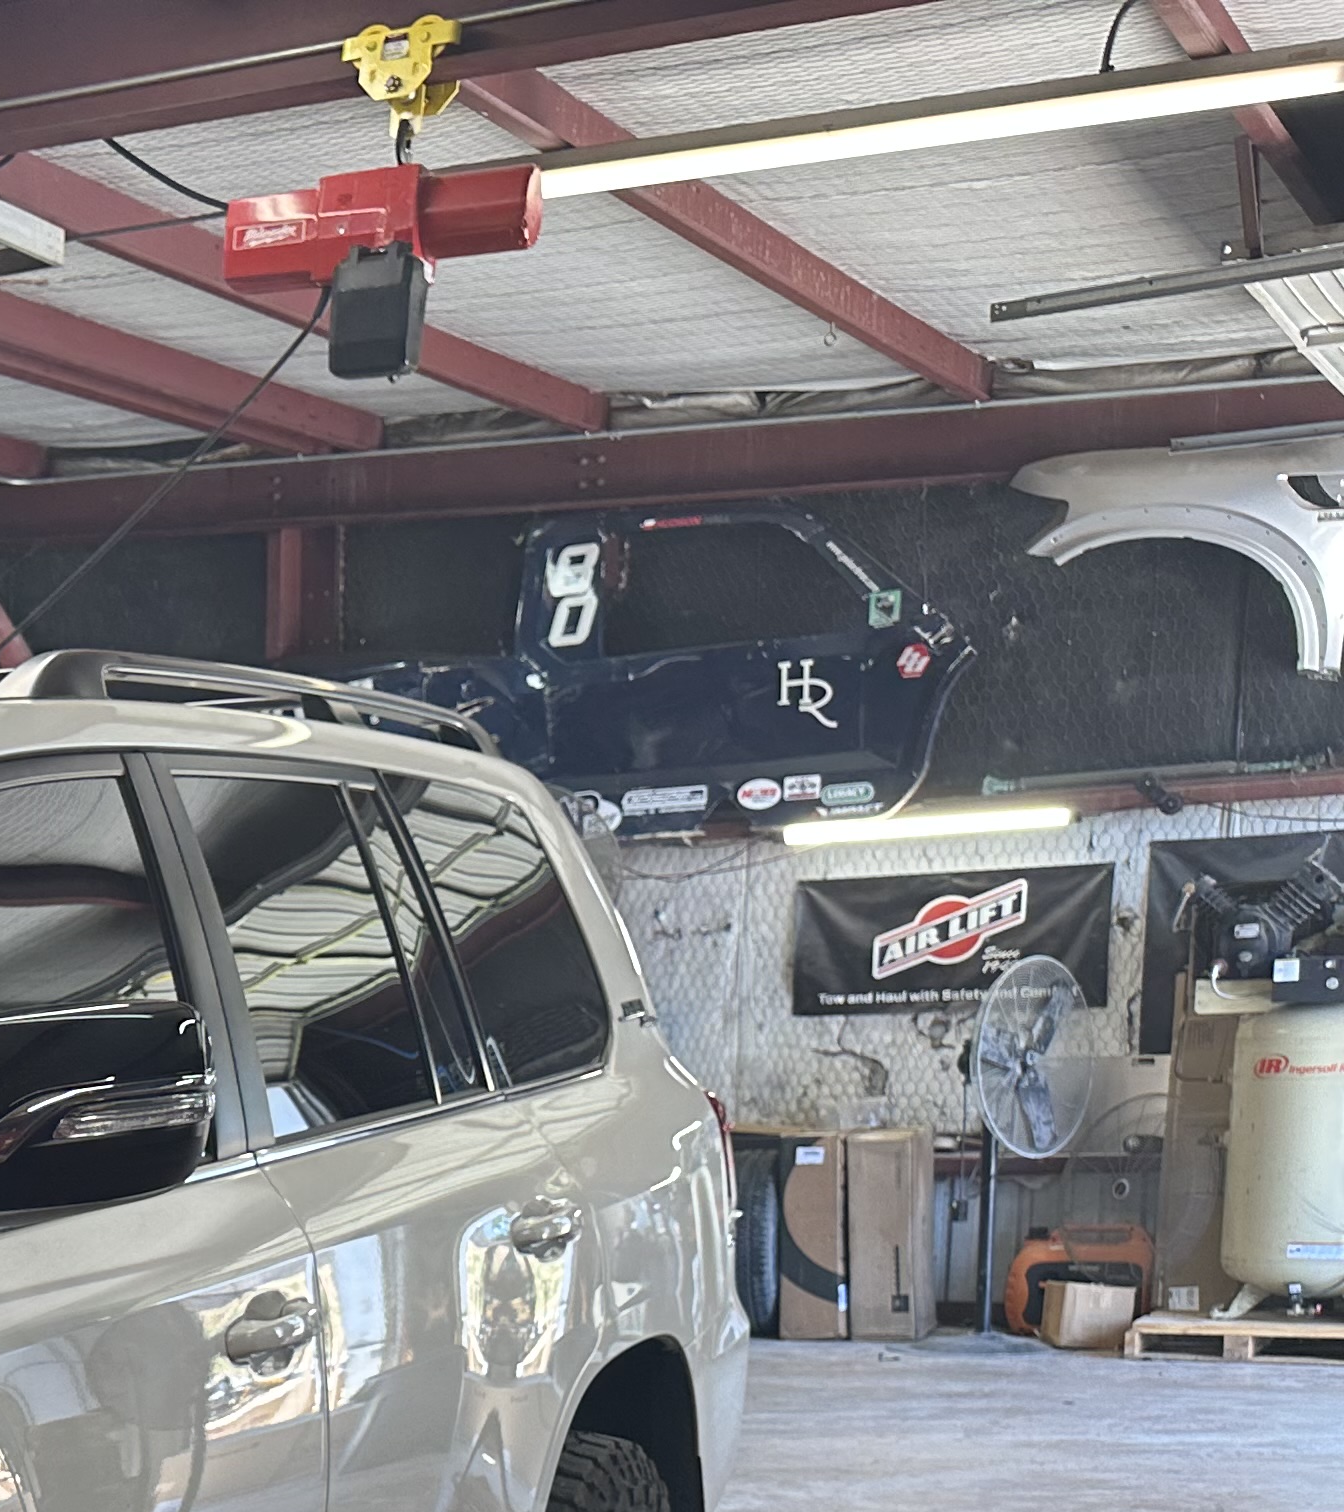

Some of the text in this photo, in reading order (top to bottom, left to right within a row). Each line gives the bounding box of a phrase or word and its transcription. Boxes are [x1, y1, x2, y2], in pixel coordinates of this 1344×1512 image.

[881, 893, 1018, 966] AIR LIFT
[818, 992, 845, 1006] Tow
[847, 991, 873, 1005] and
[875, 990, 907, 1004] Haul
[909, 989, 939, 1002] with
[941, 987, 991, 1002] Safety
[1289, 1062, 1338, 1075] Ingersoll
